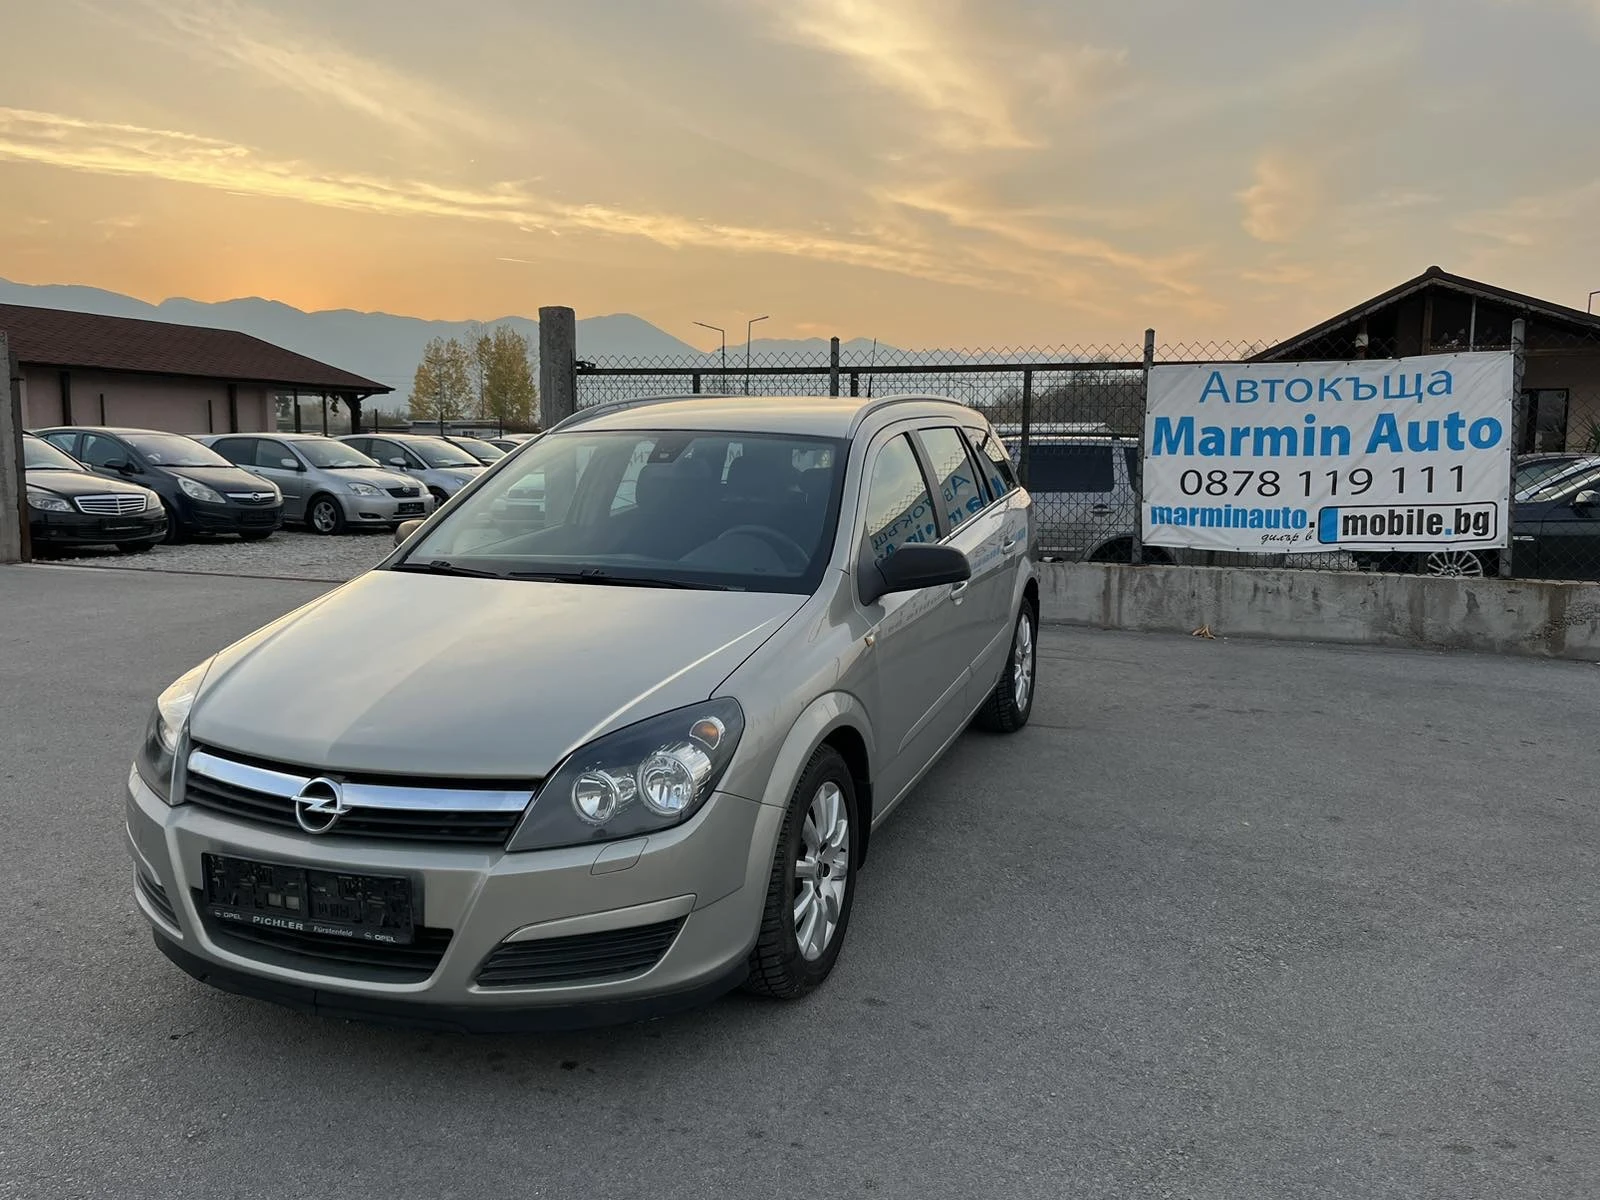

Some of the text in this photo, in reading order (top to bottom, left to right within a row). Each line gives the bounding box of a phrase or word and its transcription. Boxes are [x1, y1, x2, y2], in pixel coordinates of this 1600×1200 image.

[1199, 369, 1454, 403] Автокъща
[1151, 411, 1505, 458] Marmin Auto
[1179, 465, 1463, 497] 0878 119 111
[1342, 507, 1490, 538] mobile.bg
[223, 911, 243, 921] OPEL
[312, 924, 354, 938] Fürstenfeld
[374, 934, 397, 943] OPEL
